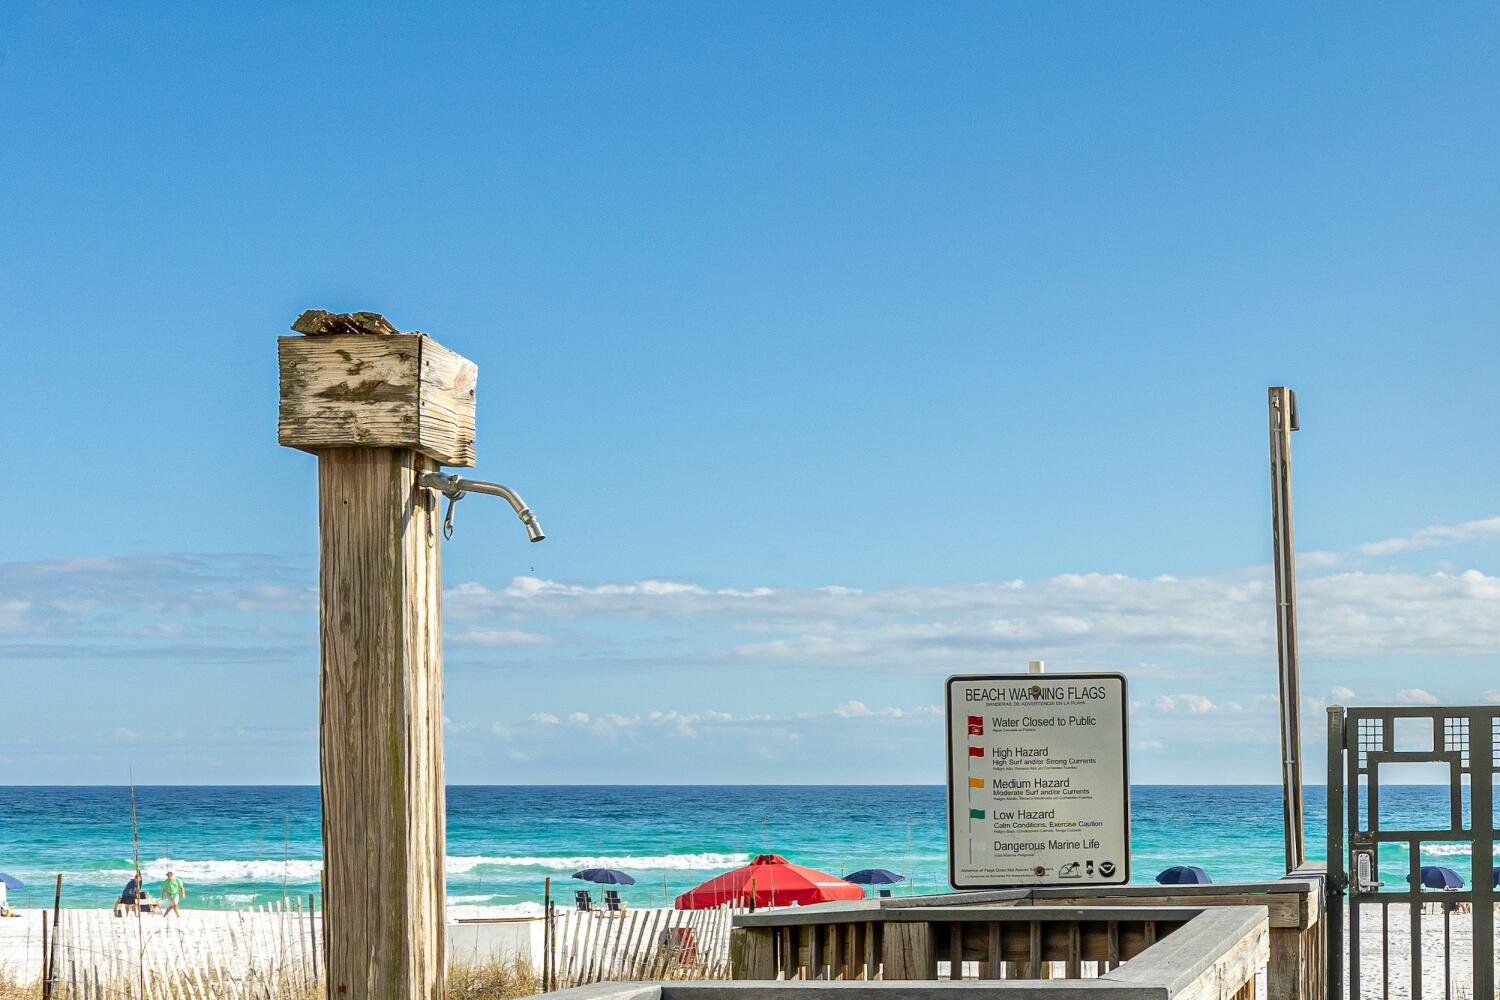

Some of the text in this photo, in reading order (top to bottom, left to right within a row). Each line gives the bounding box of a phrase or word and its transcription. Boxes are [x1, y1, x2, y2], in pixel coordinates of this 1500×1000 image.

[965, 688, 1006, 701] BEACH
[1068, 686, 1106, 700] FLAGS
[992, 716, 1097, 727] Water Closed to Public
[992, 747, 1048, 759] High Hazard
[1046, 758, 1067, 766] Strong
[993, 778, 1070, 789] Medium Hazard
[993, 809, 1055, 820] Low Hazard
[994, 839, 1100, 853] Dangerous Marine Life
